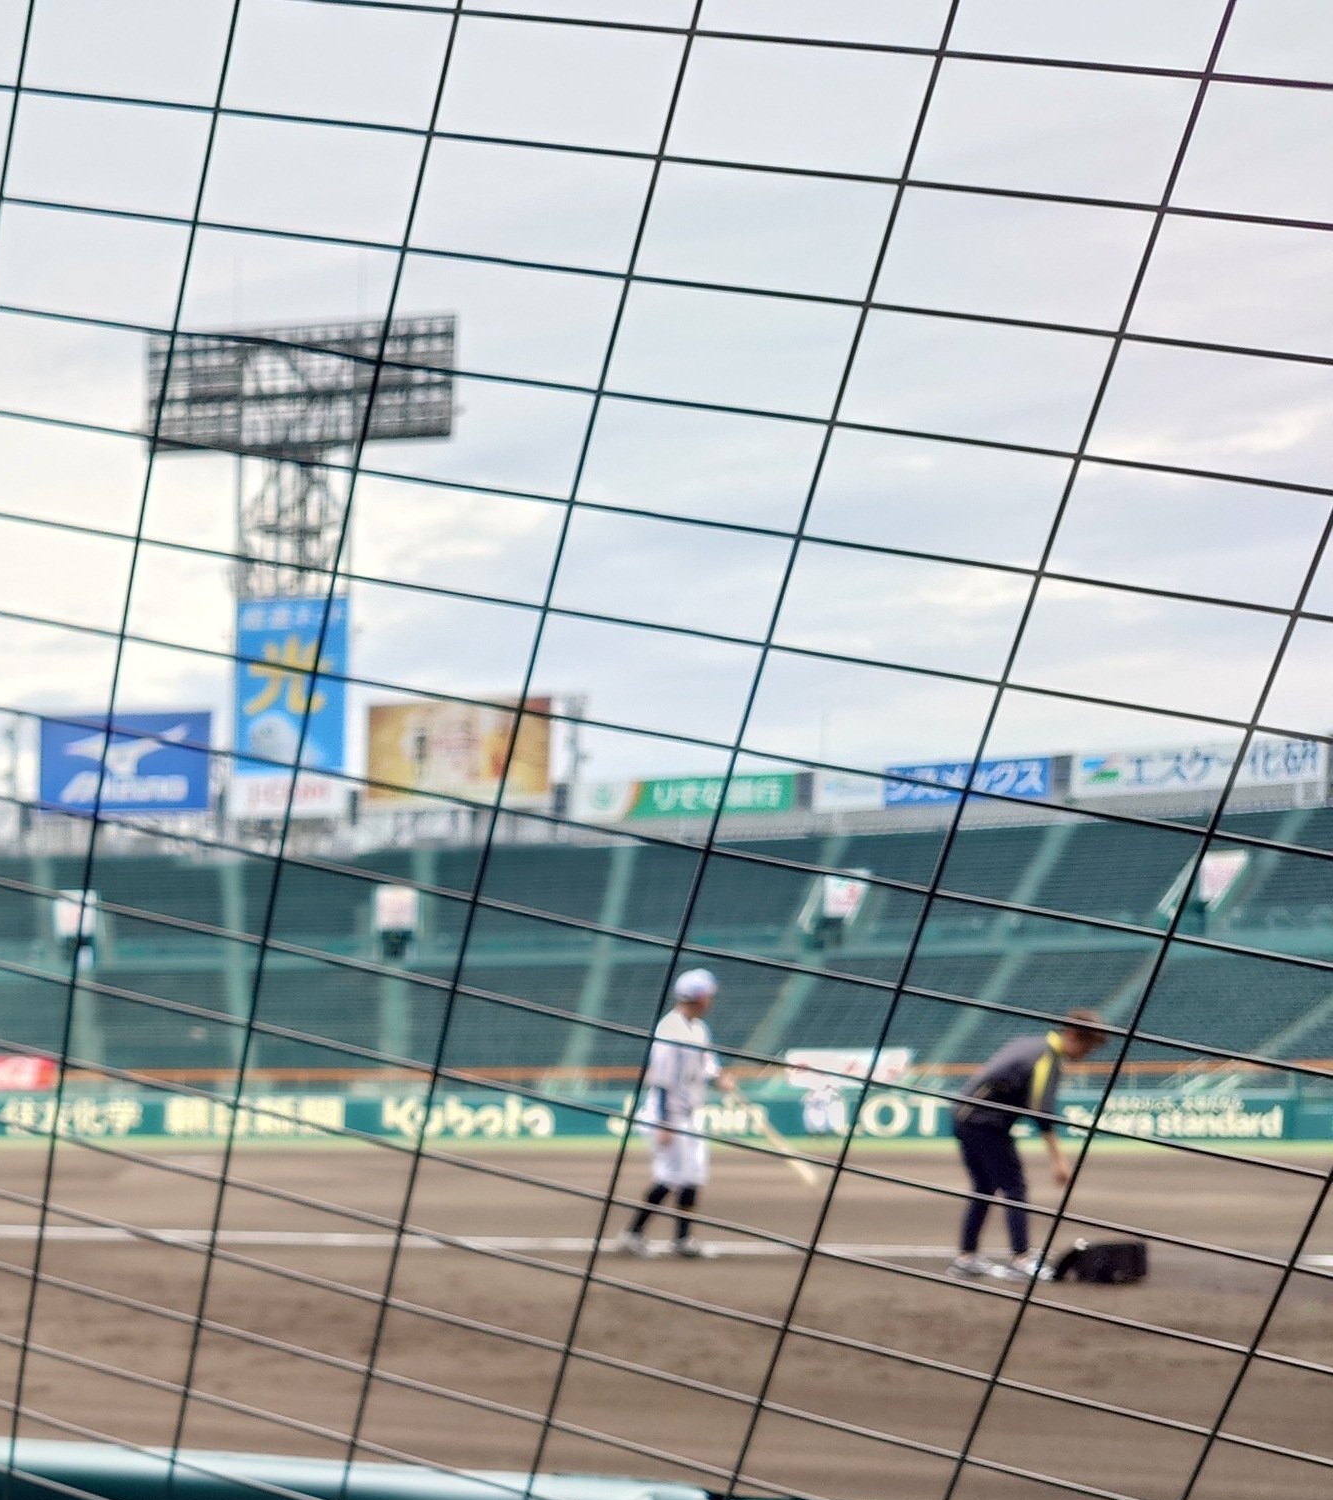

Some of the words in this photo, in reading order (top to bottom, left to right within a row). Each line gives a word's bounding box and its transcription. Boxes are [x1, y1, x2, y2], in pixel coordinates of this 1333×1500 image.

[245, 634, 331, 716] 光
[887, 761, 1046, 804] シスメックス
[1125, 741, 1319, 786] エスケー化研
[382, 1095, 555, 1138] Kubota
[1155, 1103, 1284, 1138] standard
